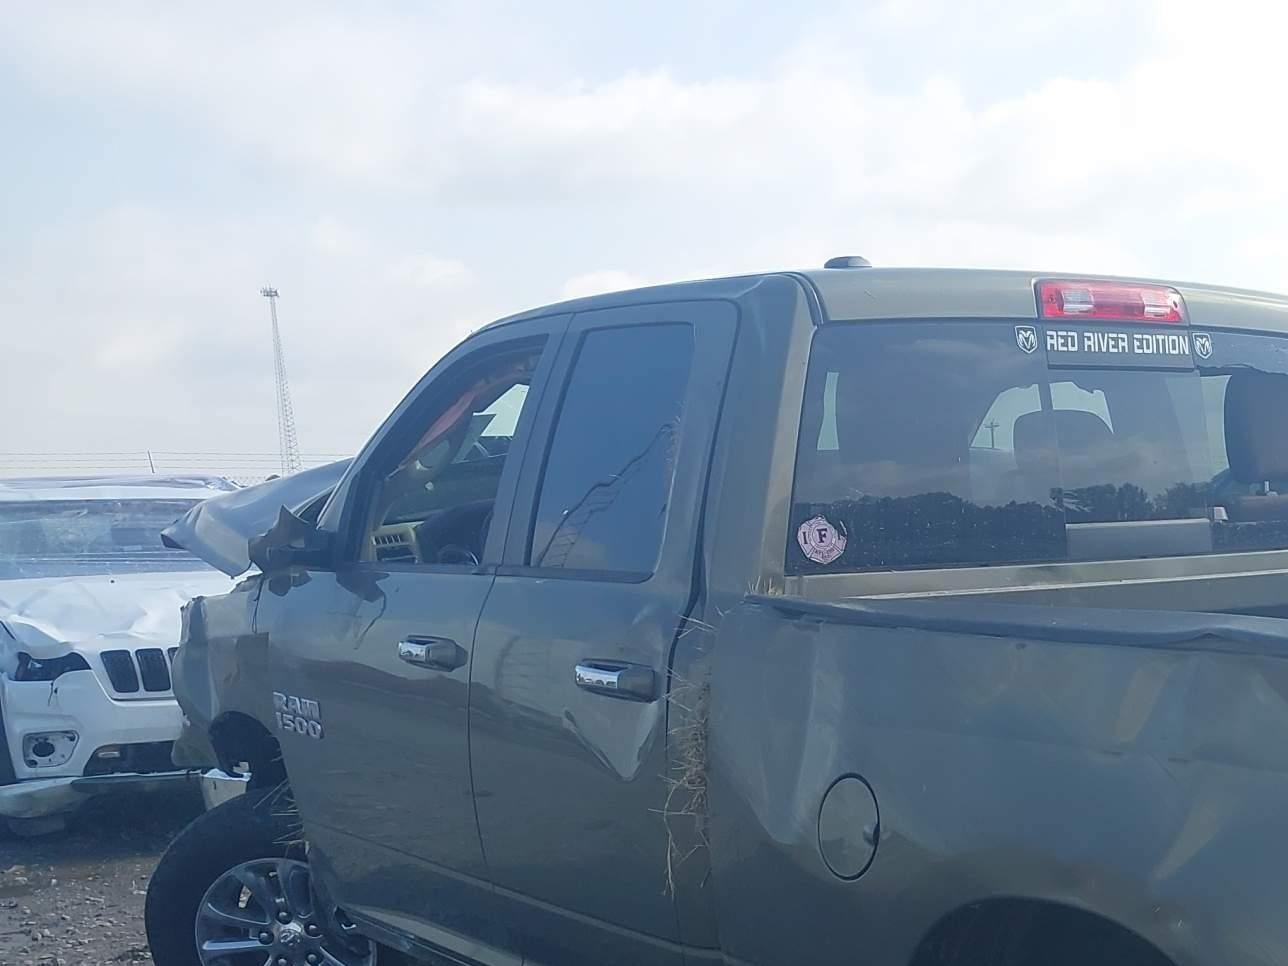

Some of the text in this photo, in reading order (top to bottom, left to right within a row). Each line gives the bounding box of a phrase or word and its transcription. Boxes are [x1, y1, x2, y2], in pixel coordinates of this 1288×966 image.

[1046, 330, 1190, 355] RED RIVER EDITION
[273, 691, 320, 720] RAM
[275, 712, 322, 739] 1500
